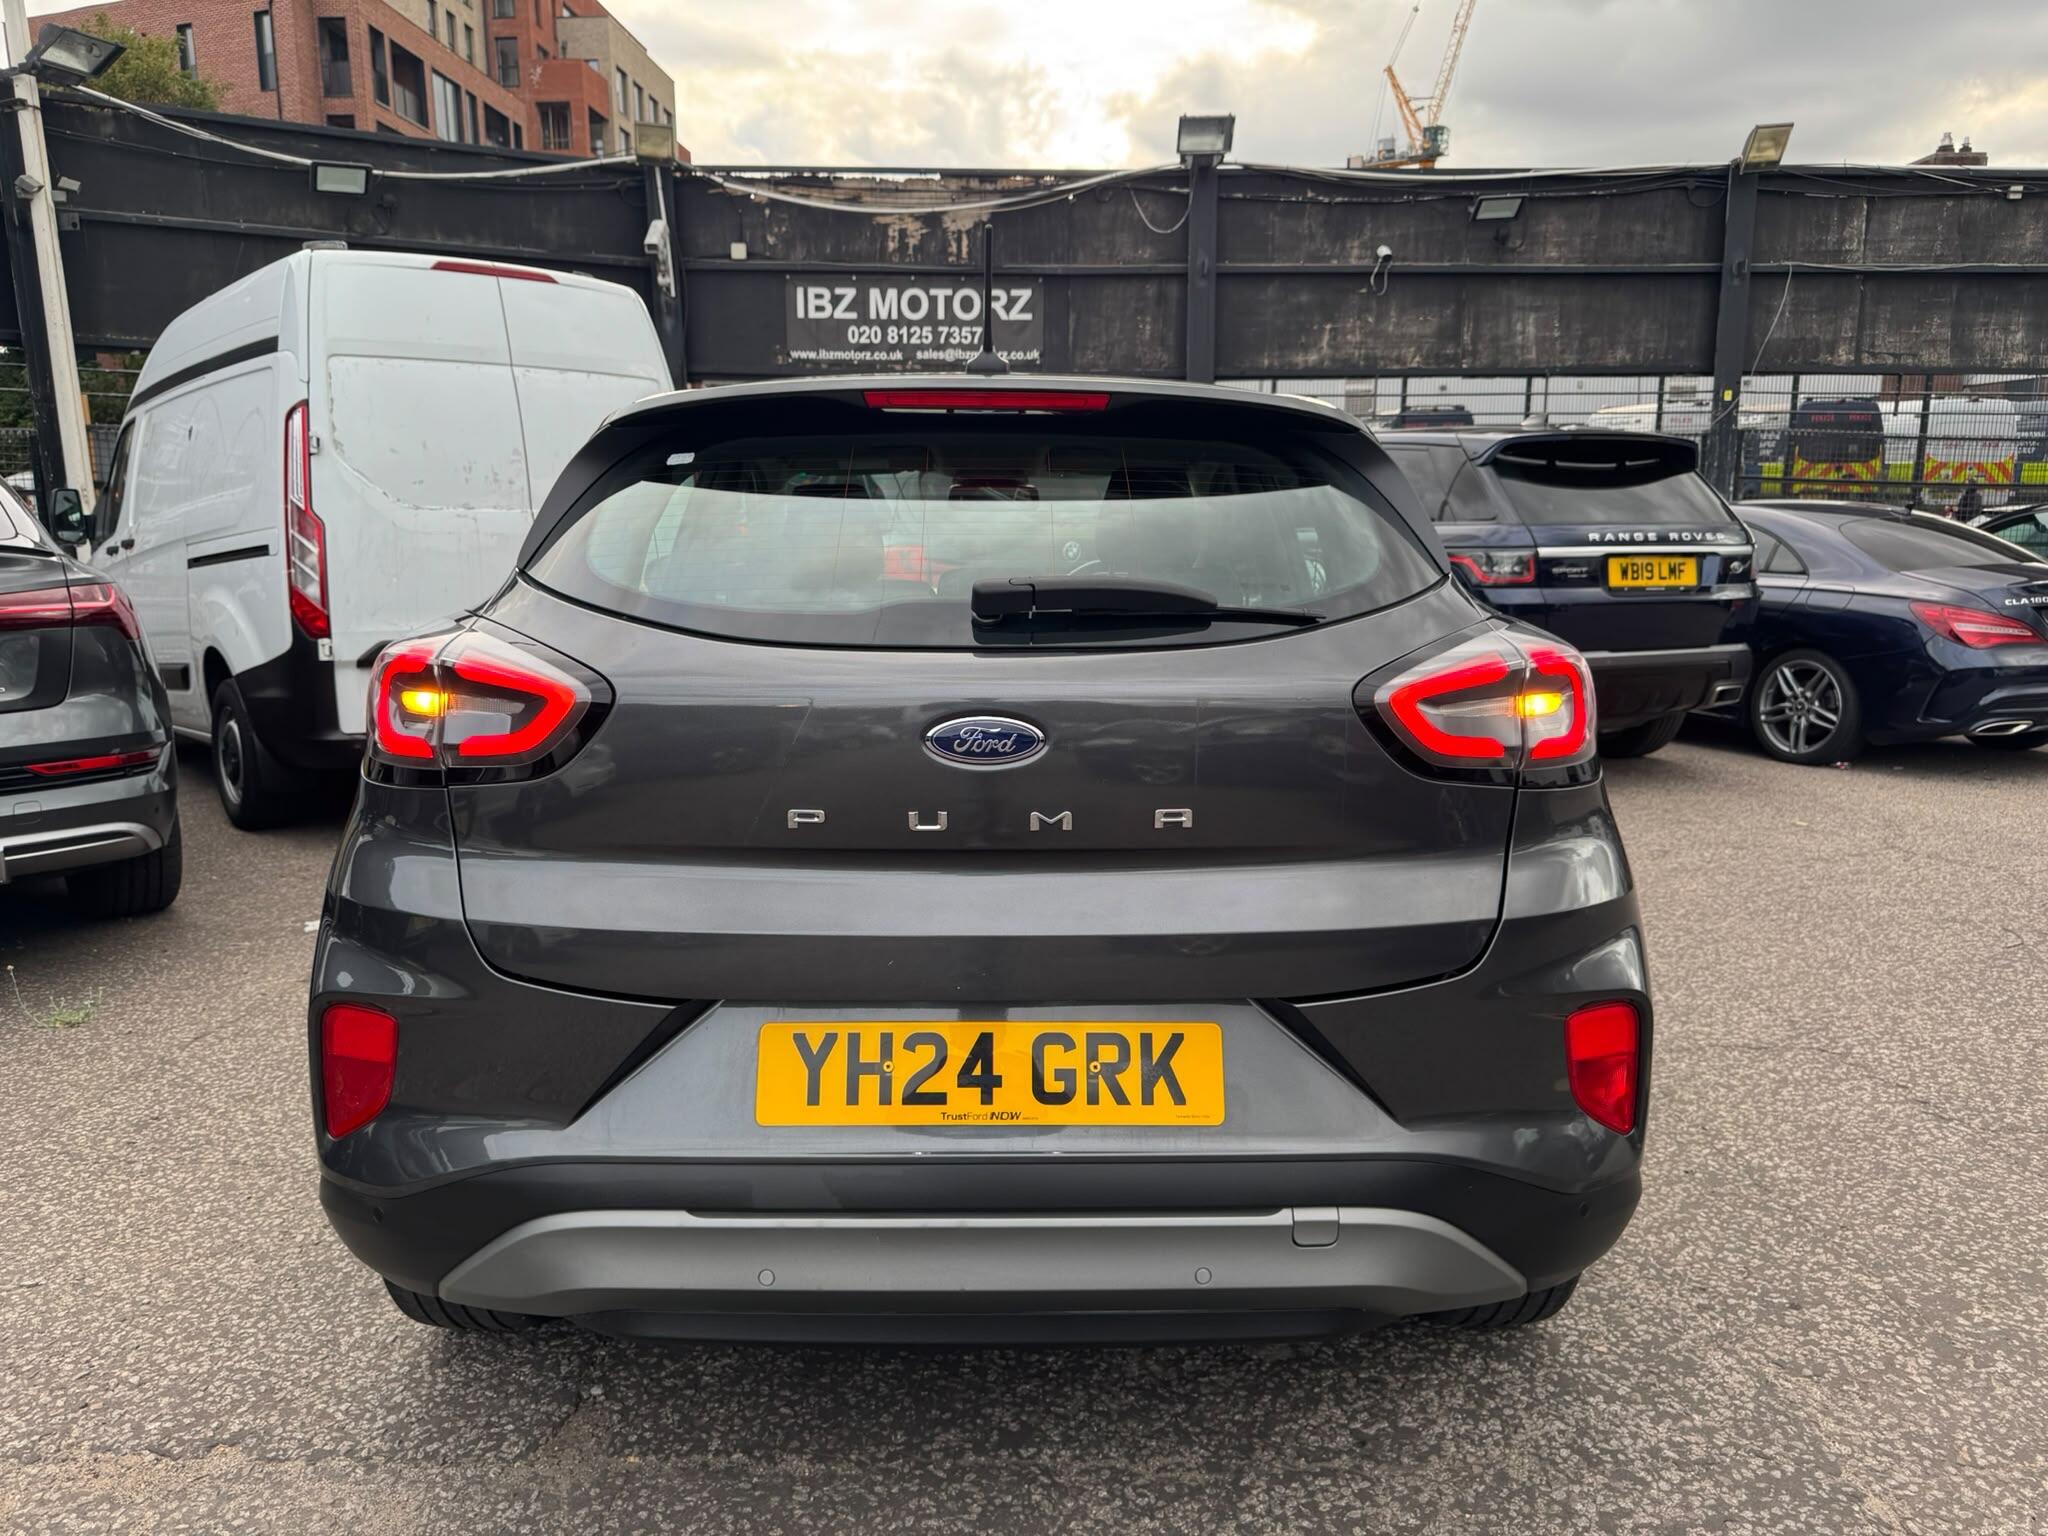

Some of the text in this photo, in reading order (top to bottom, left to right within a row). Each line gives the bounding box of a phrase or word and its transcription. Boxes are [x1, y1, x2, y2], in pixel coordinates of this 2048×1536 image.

[796, 286, 1033, 321] IBZ MOTORZ
[847, 325, 983, 344] 020 8125 7357
[789, 348, 903, 360] www.ibzmotorz.co.uk
[1588, 532, 1725, 542] RANGE ROVER
[1620, 562, 1686, 581] WB19 LMF
[953, 726, 1018, 753] Ford
[787, 808, 1193, 832] PUMA
[792, 1031, 1187, 1106] YH24 GRK
[941, 1111, 988, 1121] TrustFord
